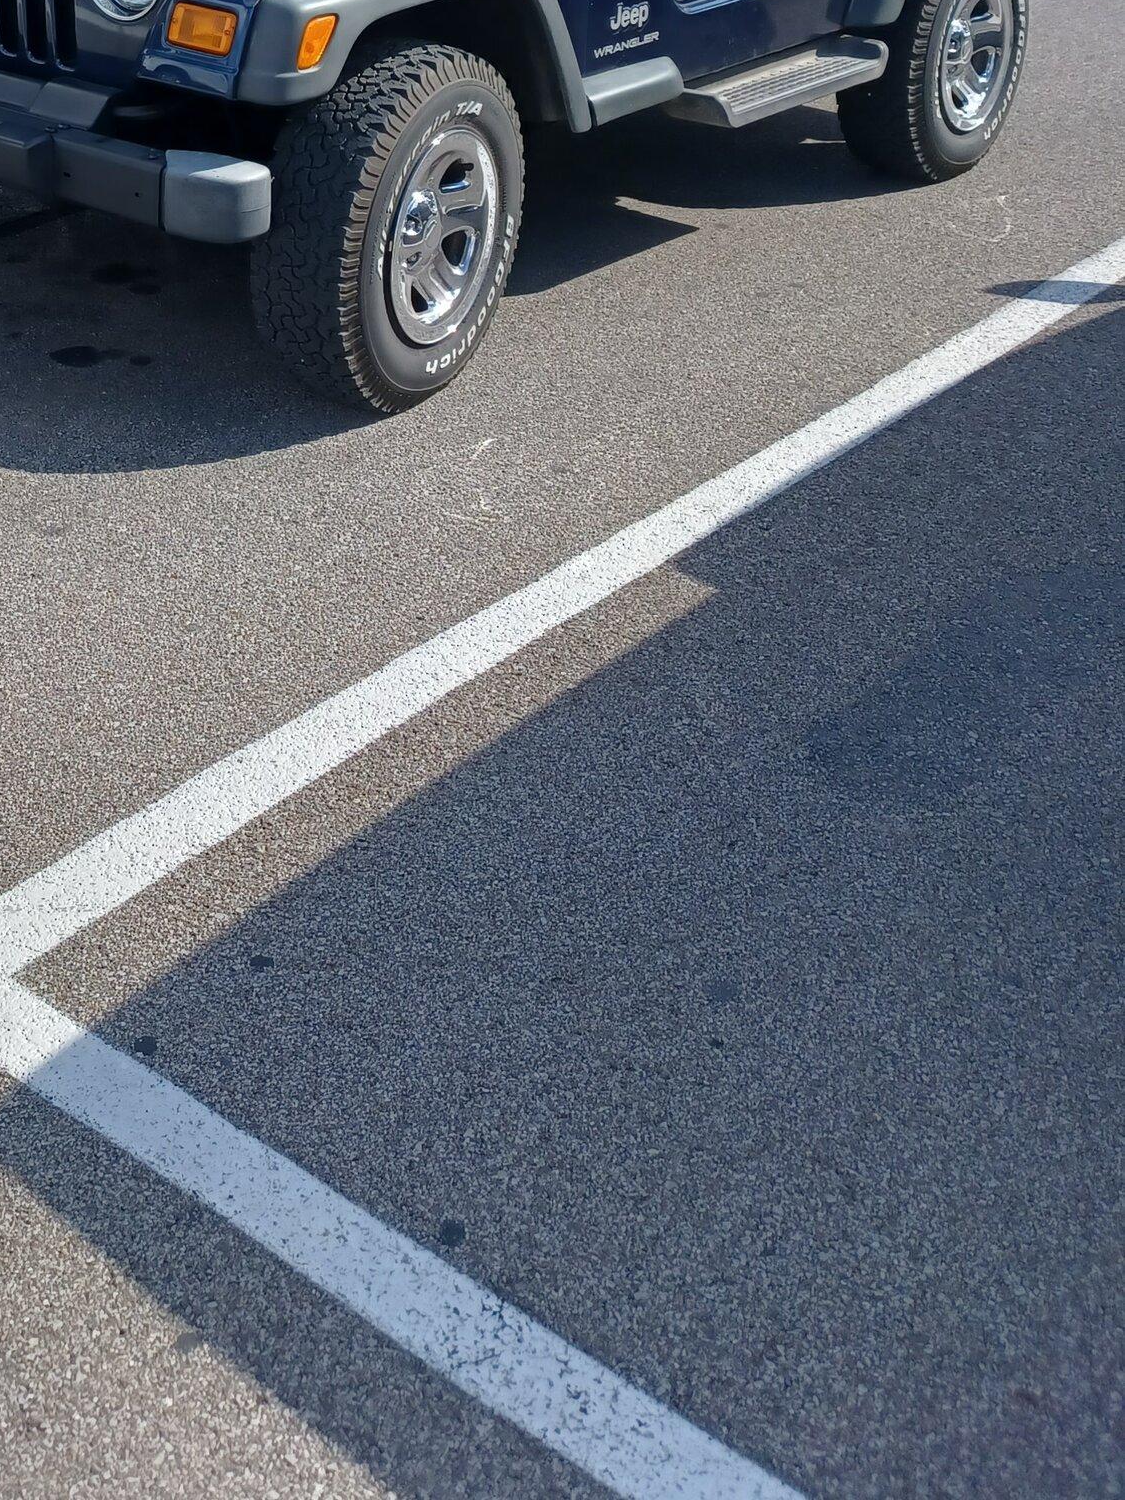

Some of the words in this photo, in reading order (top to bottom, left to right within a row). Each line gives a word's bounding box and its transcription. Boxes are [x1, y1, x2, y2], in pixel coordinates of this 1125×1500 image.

[610, 2, 649, 31] Jeep
[593, 31, 659, 59] WRANGLER
[455, 100, 484, 117] T/A
[425, 214, 515, 376] BFGoodrich
